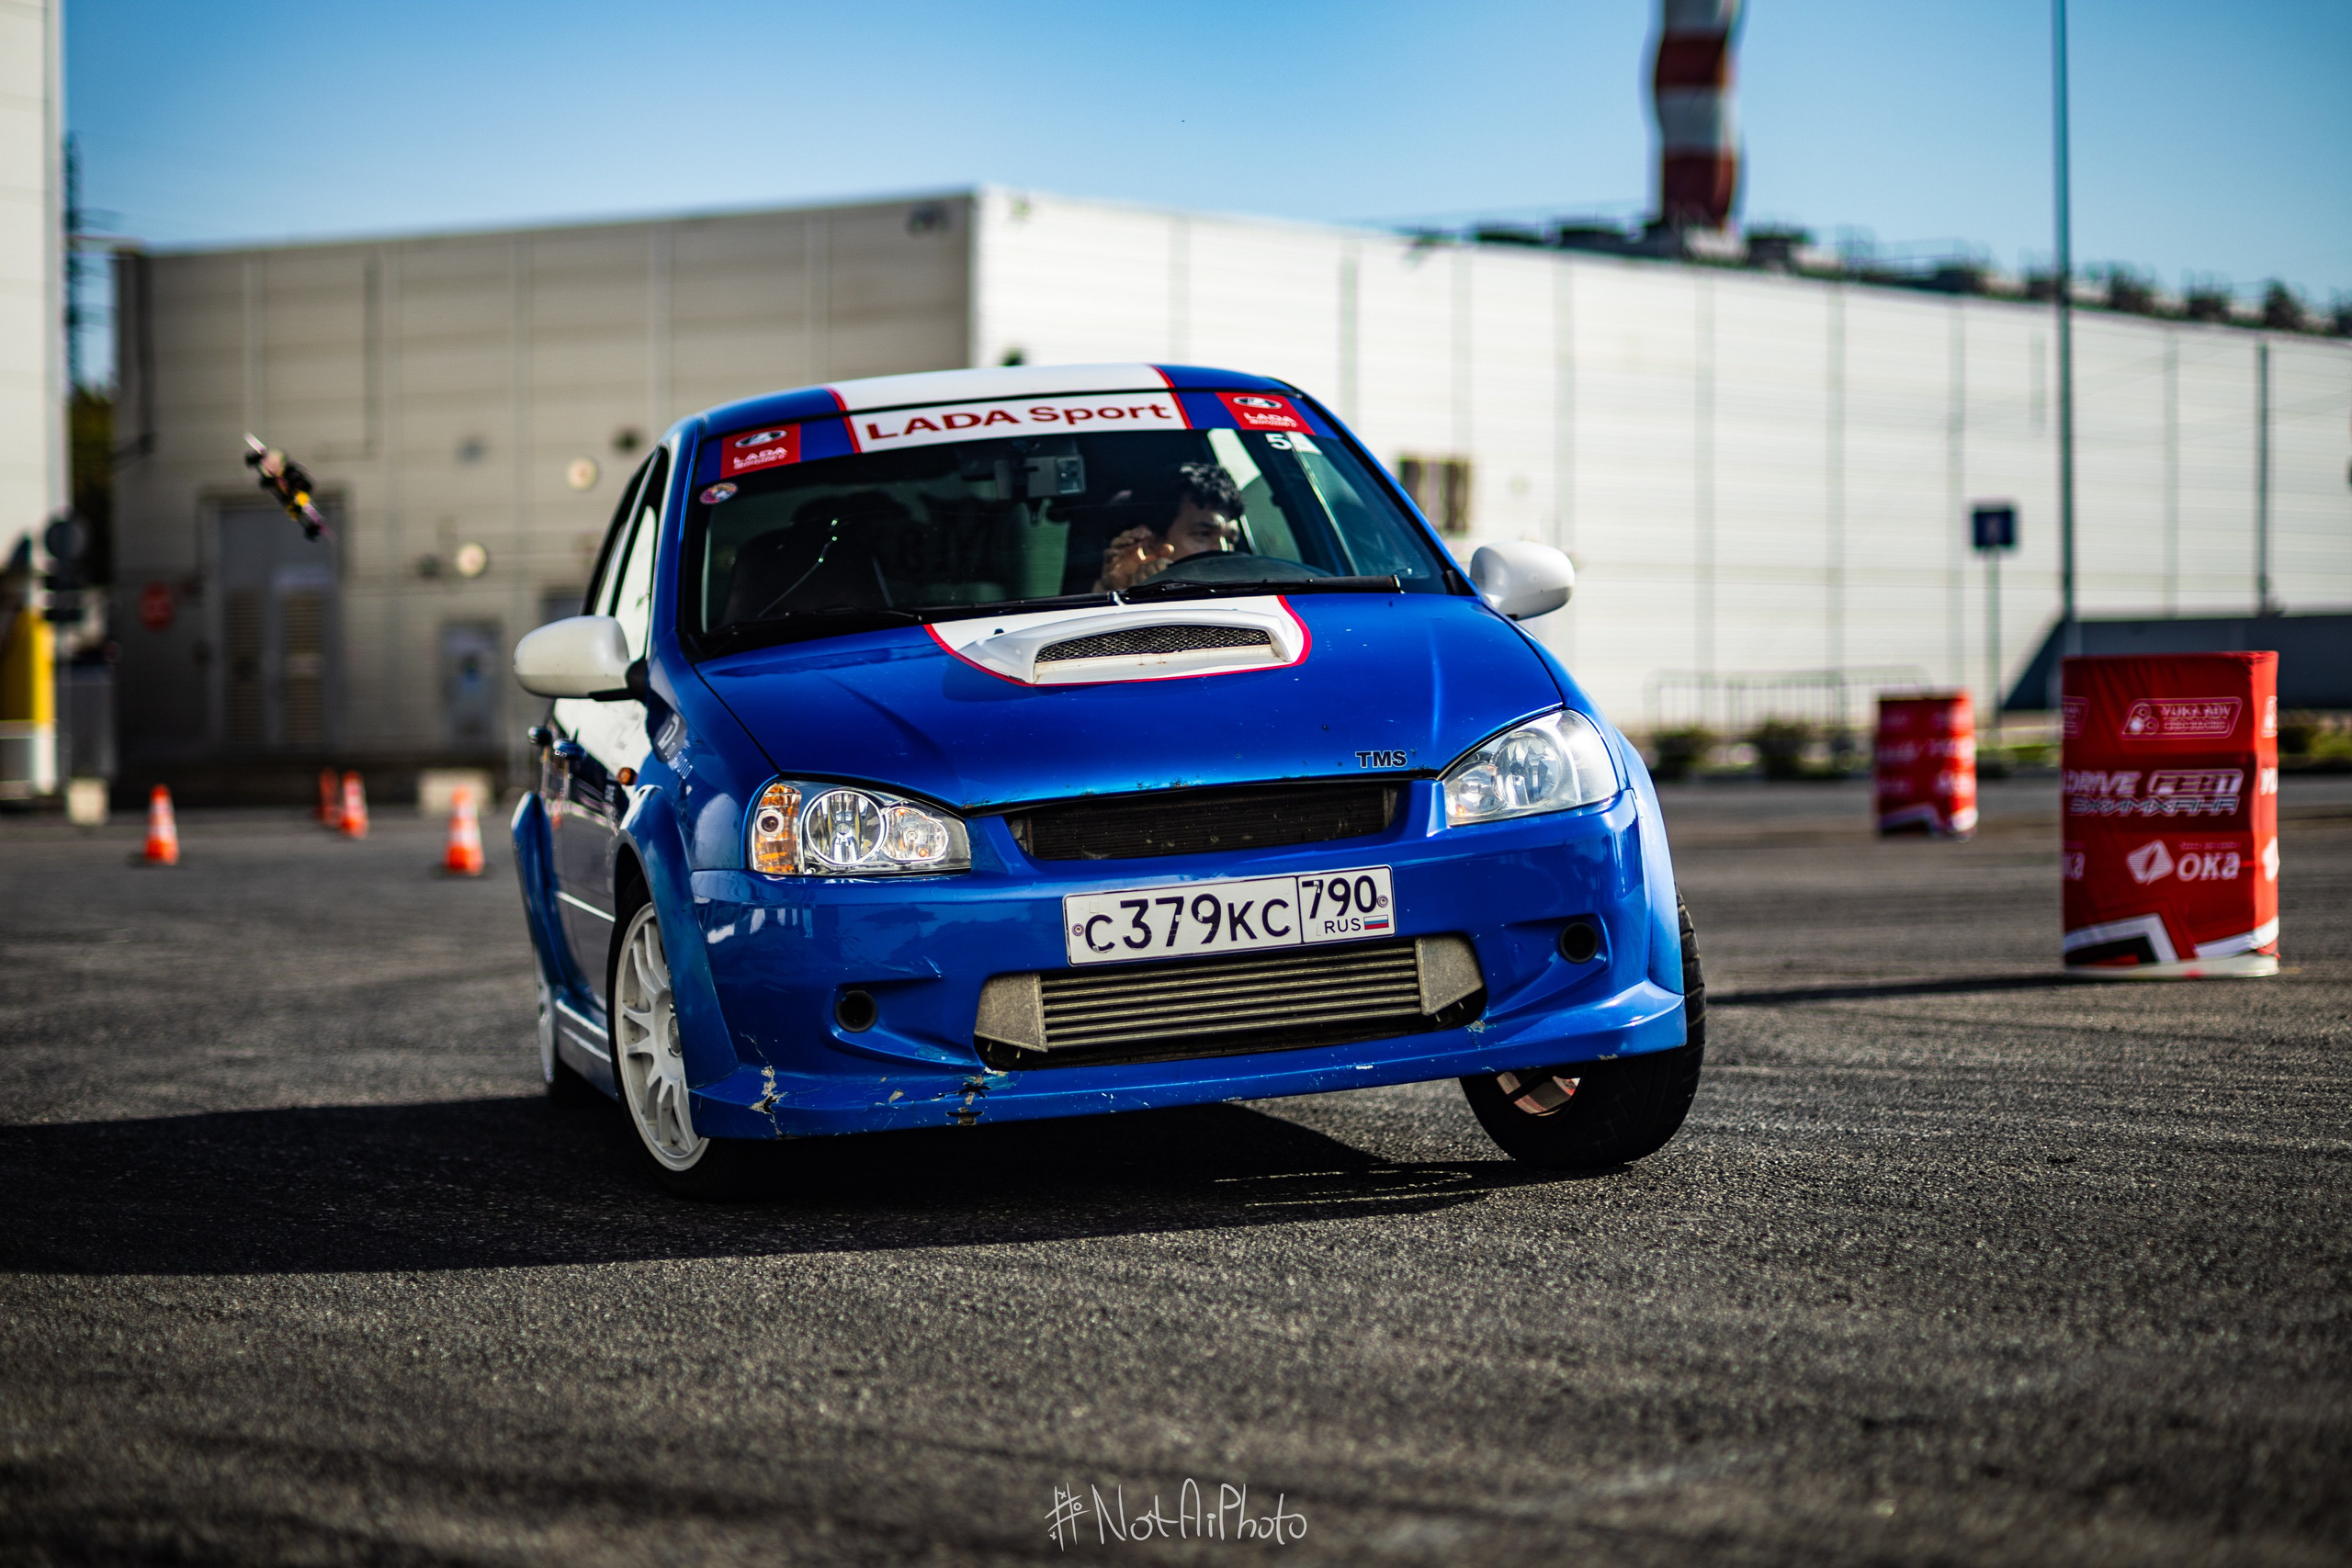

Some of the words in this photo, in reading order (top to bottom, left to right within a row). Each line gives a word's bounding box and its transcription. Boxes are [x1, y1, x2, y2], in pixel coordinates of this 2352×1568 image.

[866, 410, 1021, 440] LADA
[1029, 404, 1172, 424] Sport
[1355, 750, 1408, 768] TMS
[1084, 893, 1291, 953] С379КС
[1302, 875, 1377, 919] 790
[1325, 918, 1362, 934] RUS
